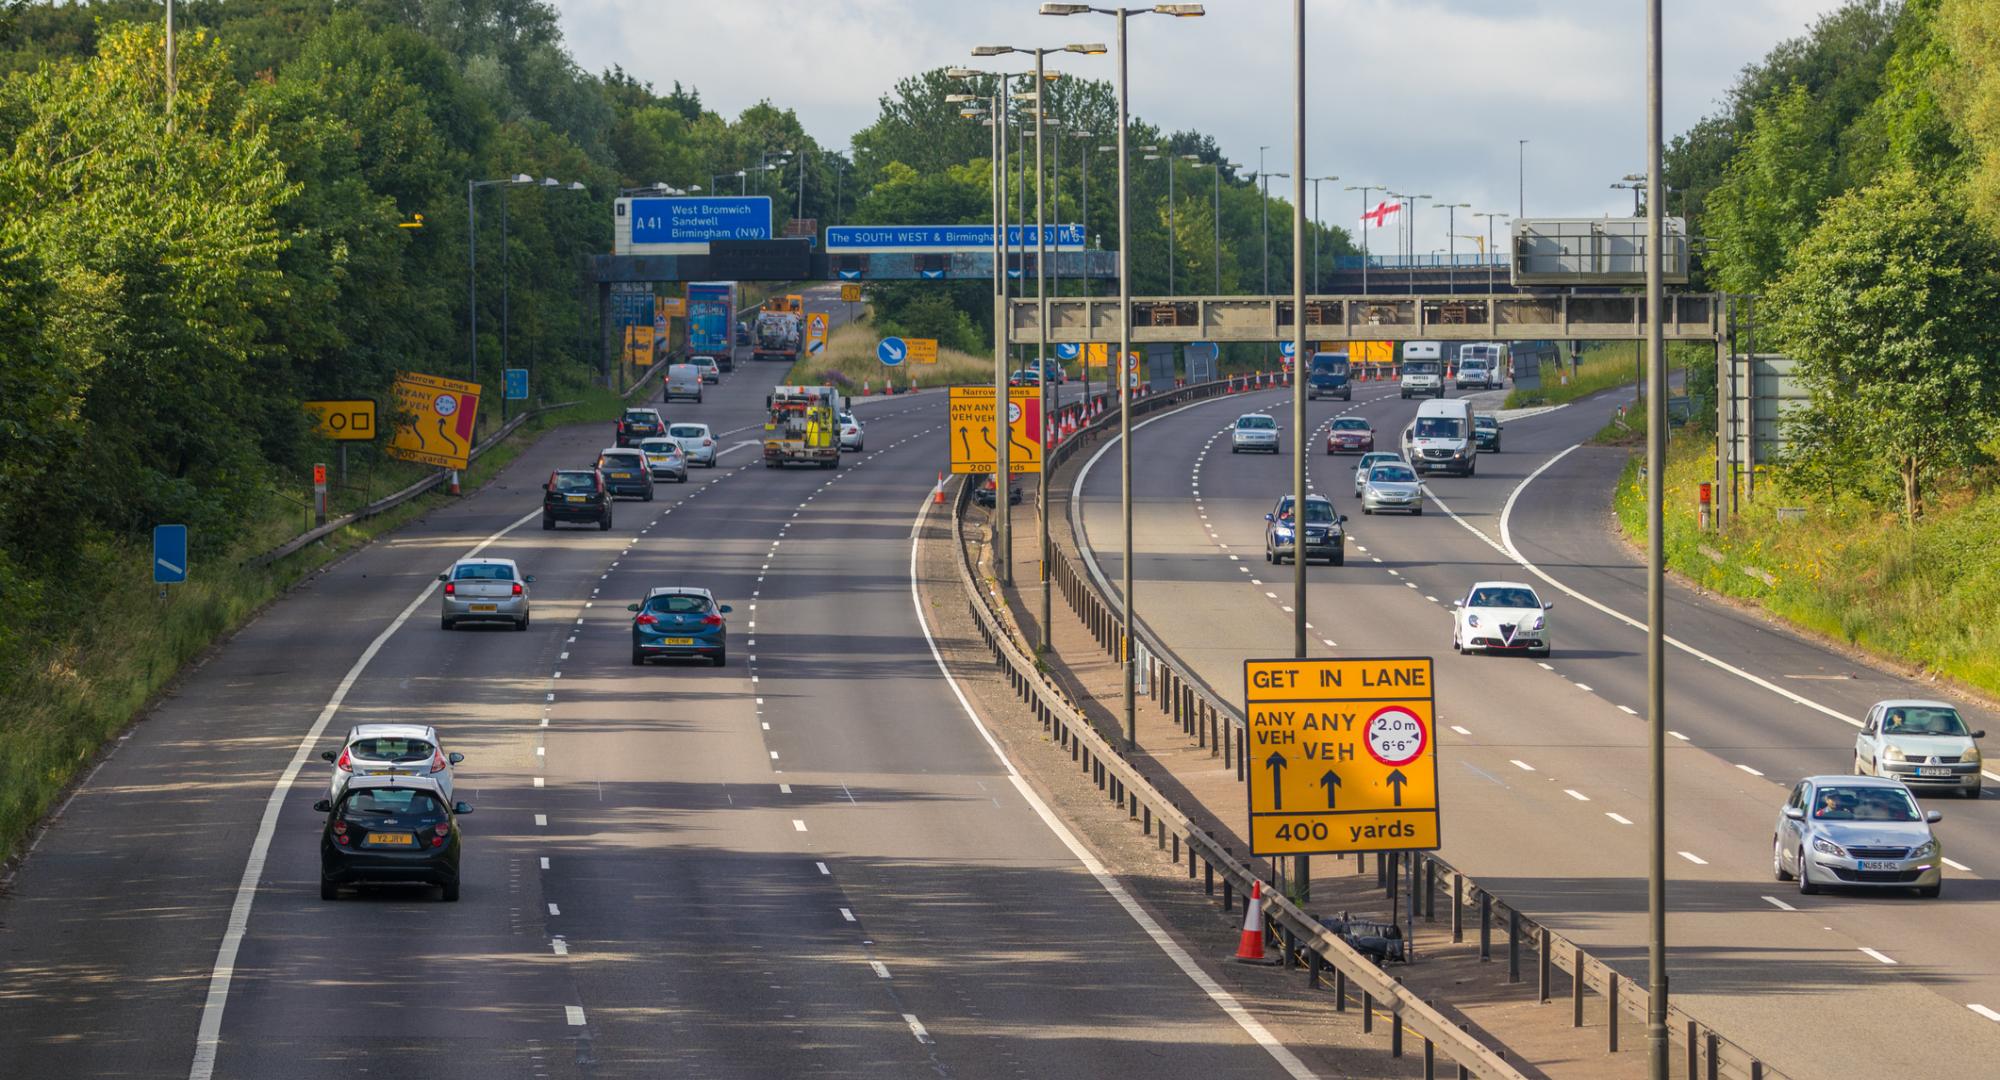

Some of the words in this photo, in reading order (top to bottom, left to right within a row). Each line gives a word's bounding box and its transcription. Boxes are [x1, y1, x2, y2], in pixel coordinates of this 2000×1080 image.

[672, 205, 697, 215] West
[702, 205, 751, 215] Bromwich
[672, 216, 718, 226] Sandwell
[672, 228, 730, 239] Birmingham
[735, 228, 765, 239] (NW)
[832, 233, 849, 242] The
[855, 232, 893, 242] SOUTH
[897, 232, 928, 242] WEST
[933, 233, 941, 242] &
[442, 380, 468, 391] Lanes
[411, 390, 432, 401] ANY
[974, 403, 995, 411] ANY
[952, 413, 973, 421] VEH
[974, 414, 995, 422] VEH
[970, 464, 992, 472] 200
[1253, 669, 1299, 689] GET
[1319, 668, 1343, 688] IN
[1361, 668, 1426, 687] LANE
[1254, 711, 1296, 727] ANY
[1302, 713, 1356, 731] ANY
[1257, 730, 1295, 745] VEH
[1302, 742, 1354, 761] VEH
[1275, 822, 1329, 842] 400
[1349, 819, 1415, 842] yards
